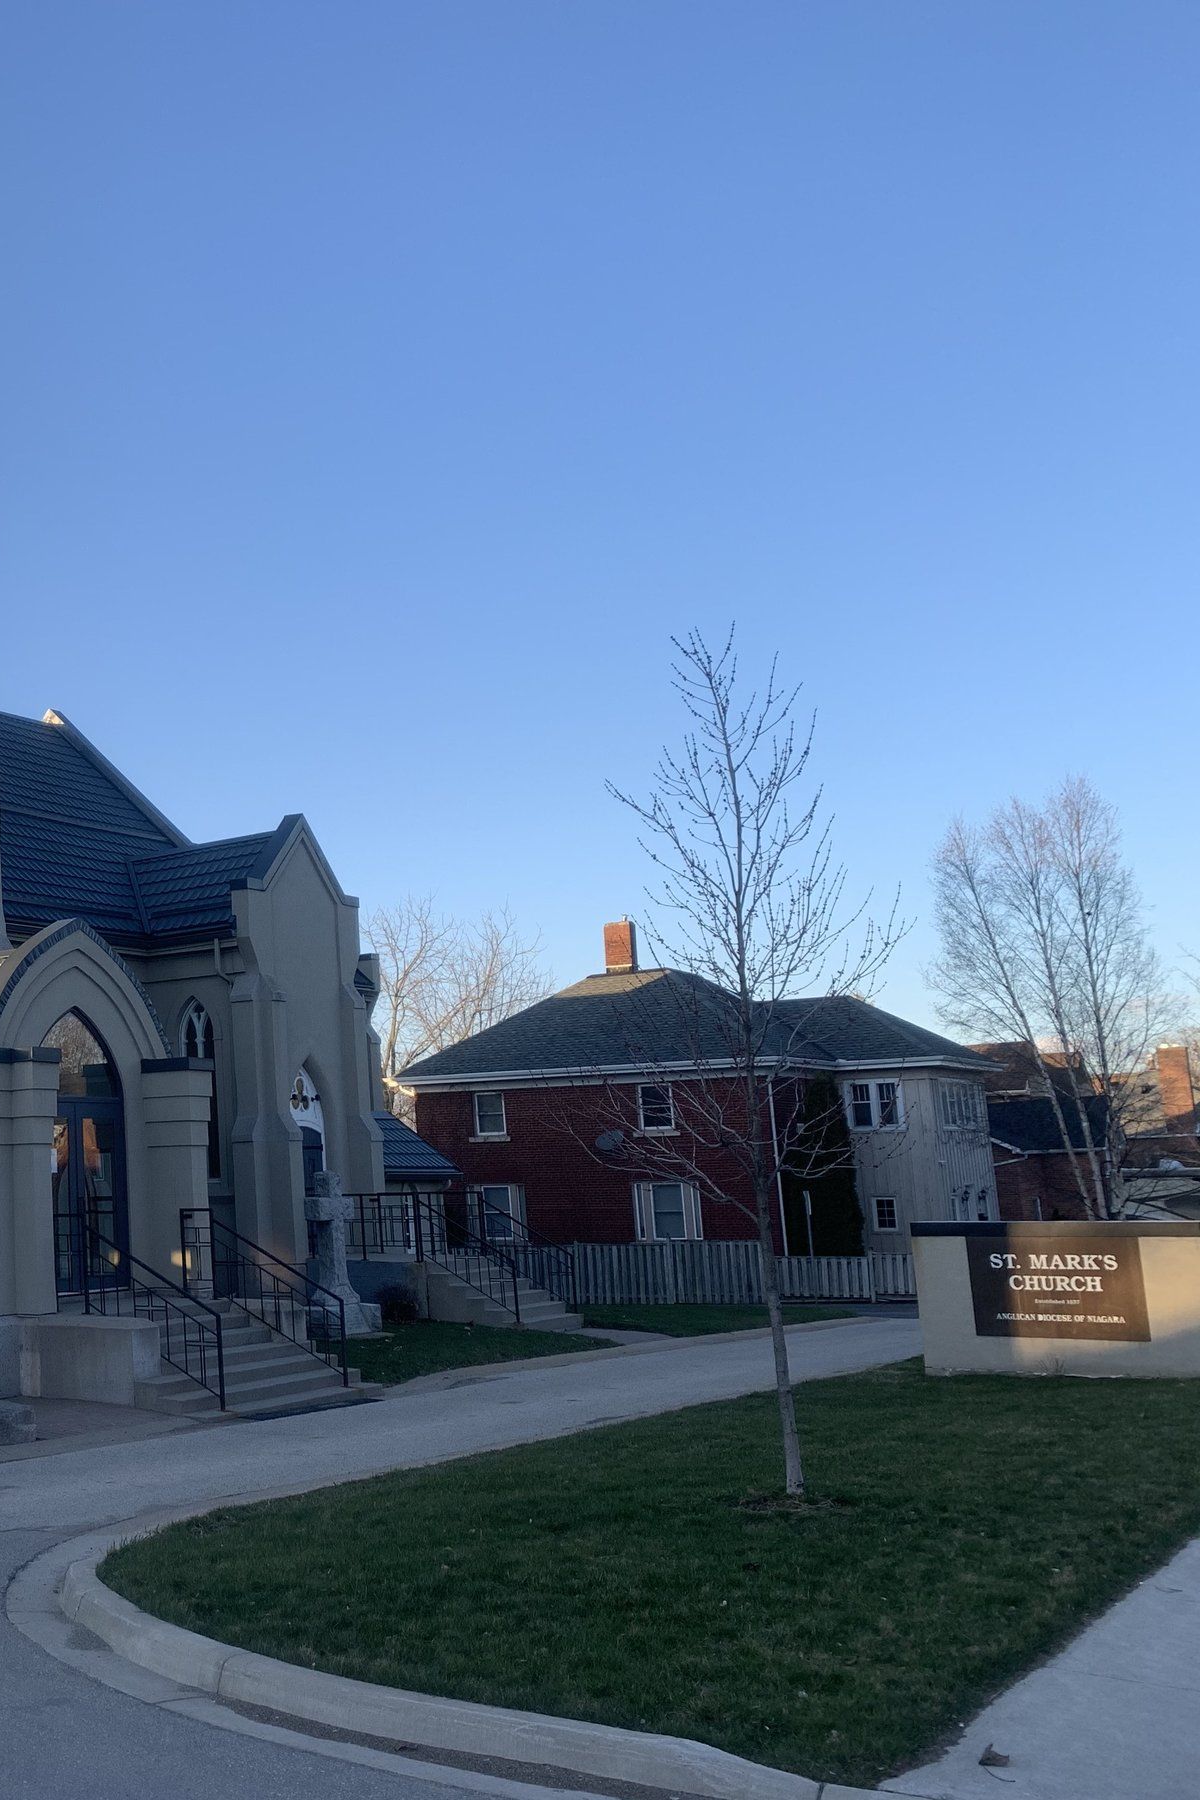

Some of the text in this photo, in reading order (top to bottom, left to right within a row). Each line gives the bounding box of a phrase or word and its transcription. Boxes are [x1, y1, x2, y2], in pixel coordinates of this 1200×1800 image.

[989, 1253, 1119, 1271] ST. MARK'S
[1009, 1275, 1104, 1292] CHURCH
[996, 1312, 1126, 1324] ANGLICAN DIOCESE OF NIAGARA
